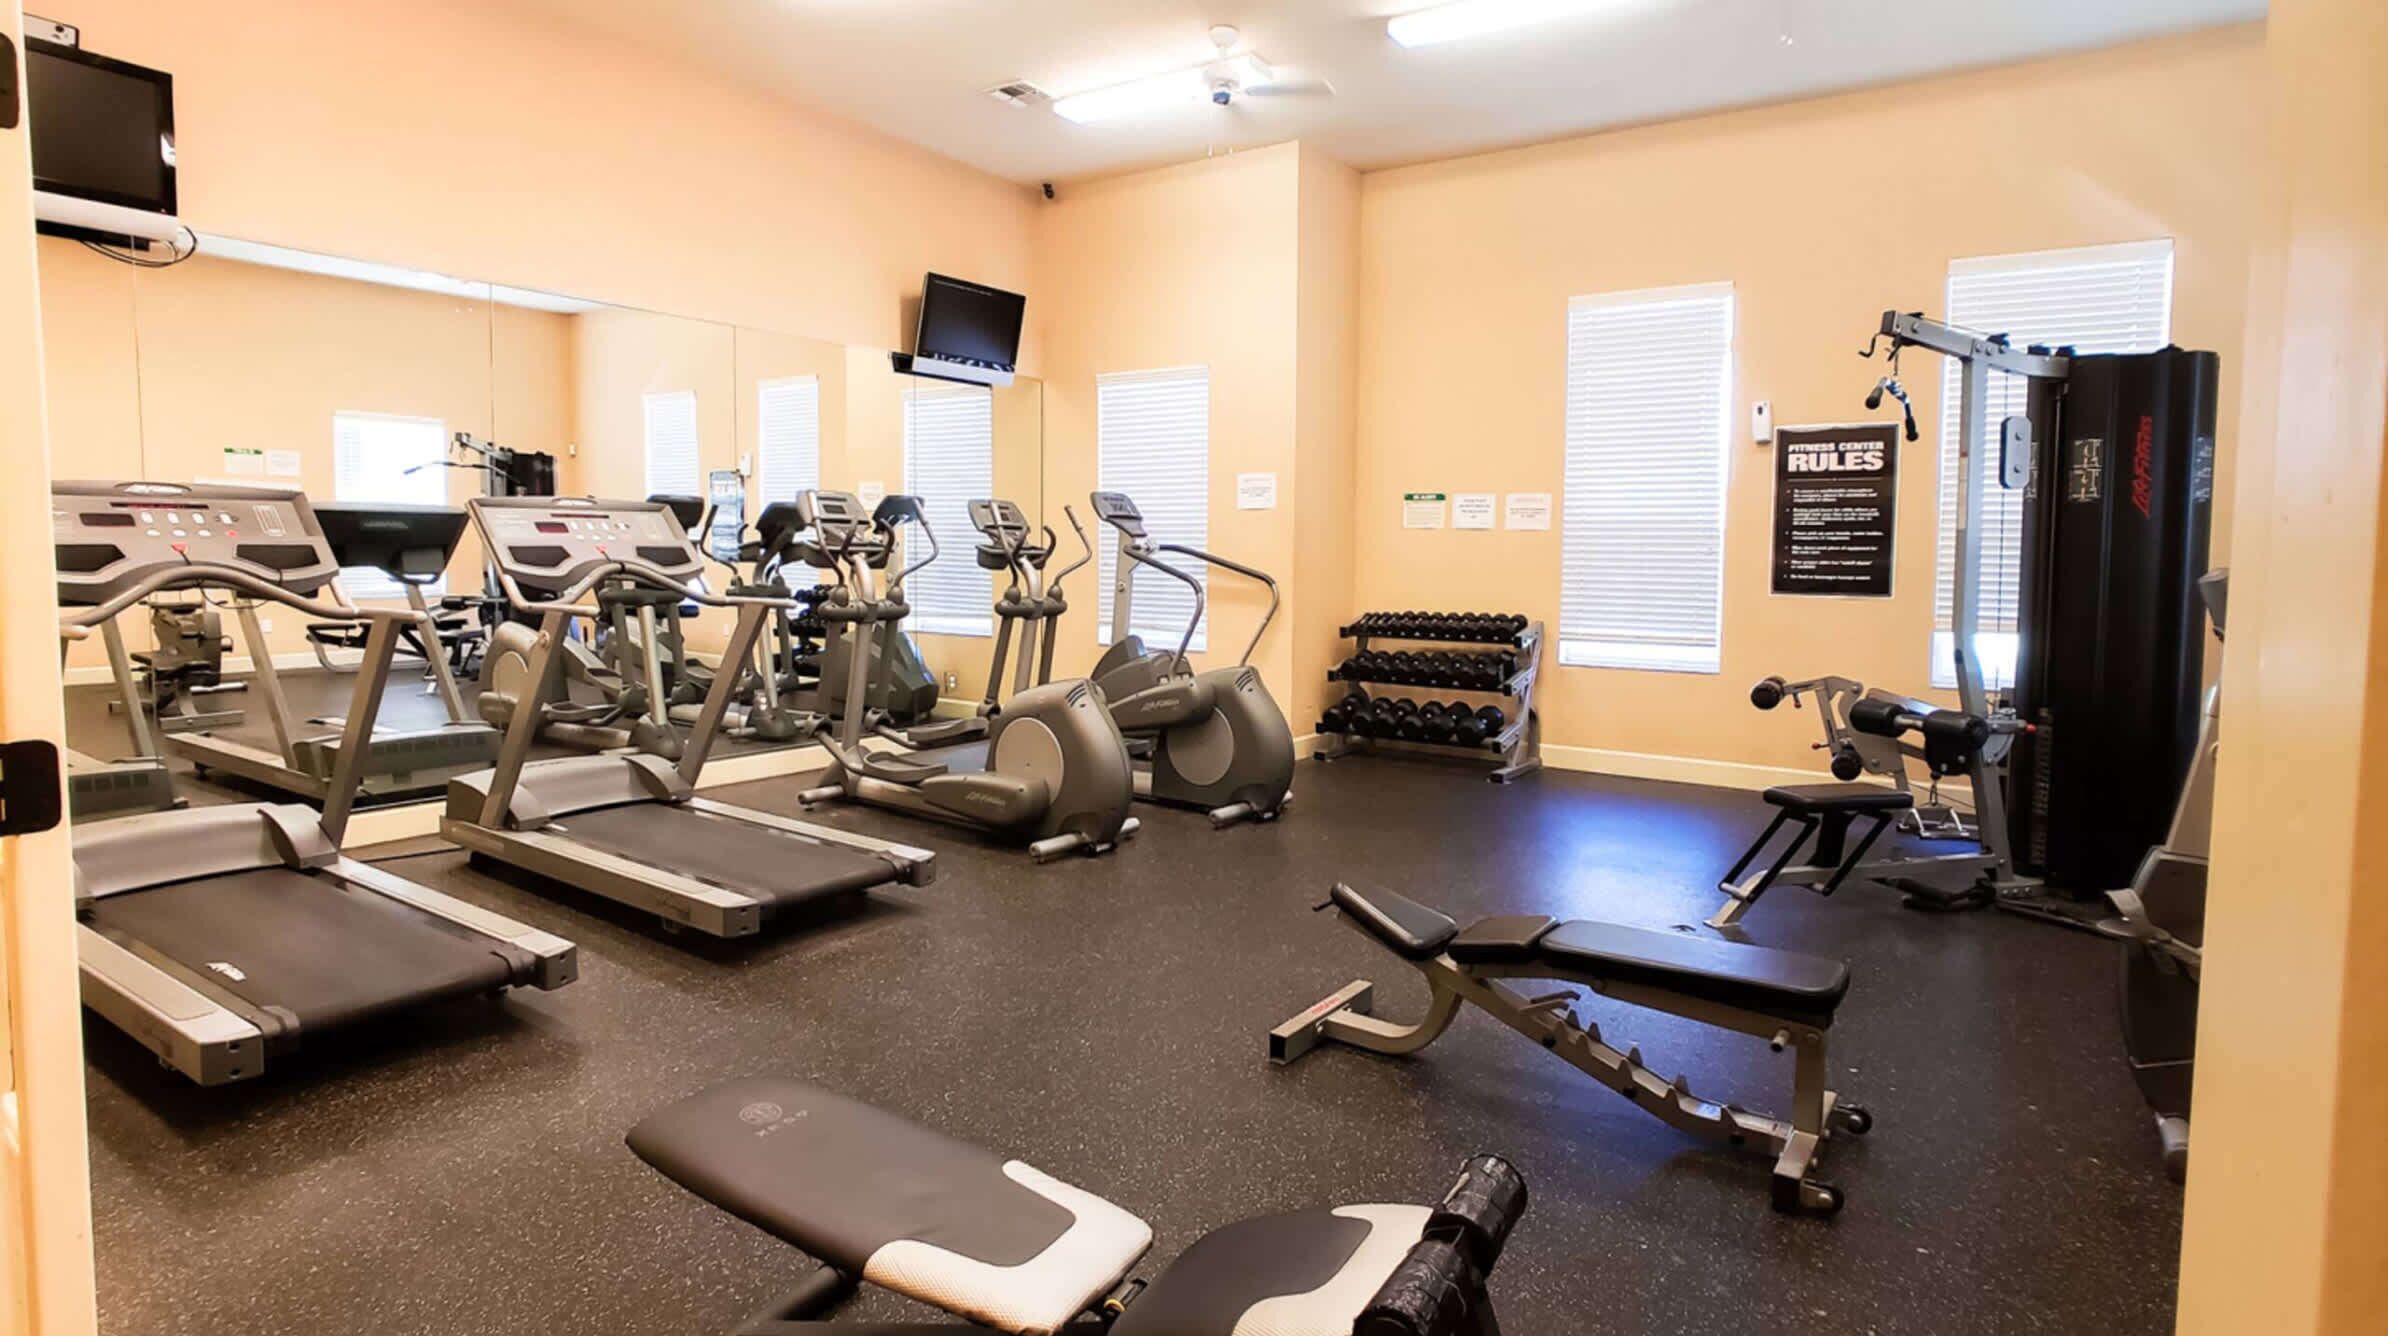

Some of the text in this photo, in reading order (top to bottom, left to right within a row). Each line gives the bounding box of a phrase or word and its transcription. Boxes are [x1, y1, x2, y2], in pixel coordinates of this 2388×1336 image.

[1788, 441, 1884, 452] FITNESS CENTER
[1788, 451, 1884, 472] RULES
